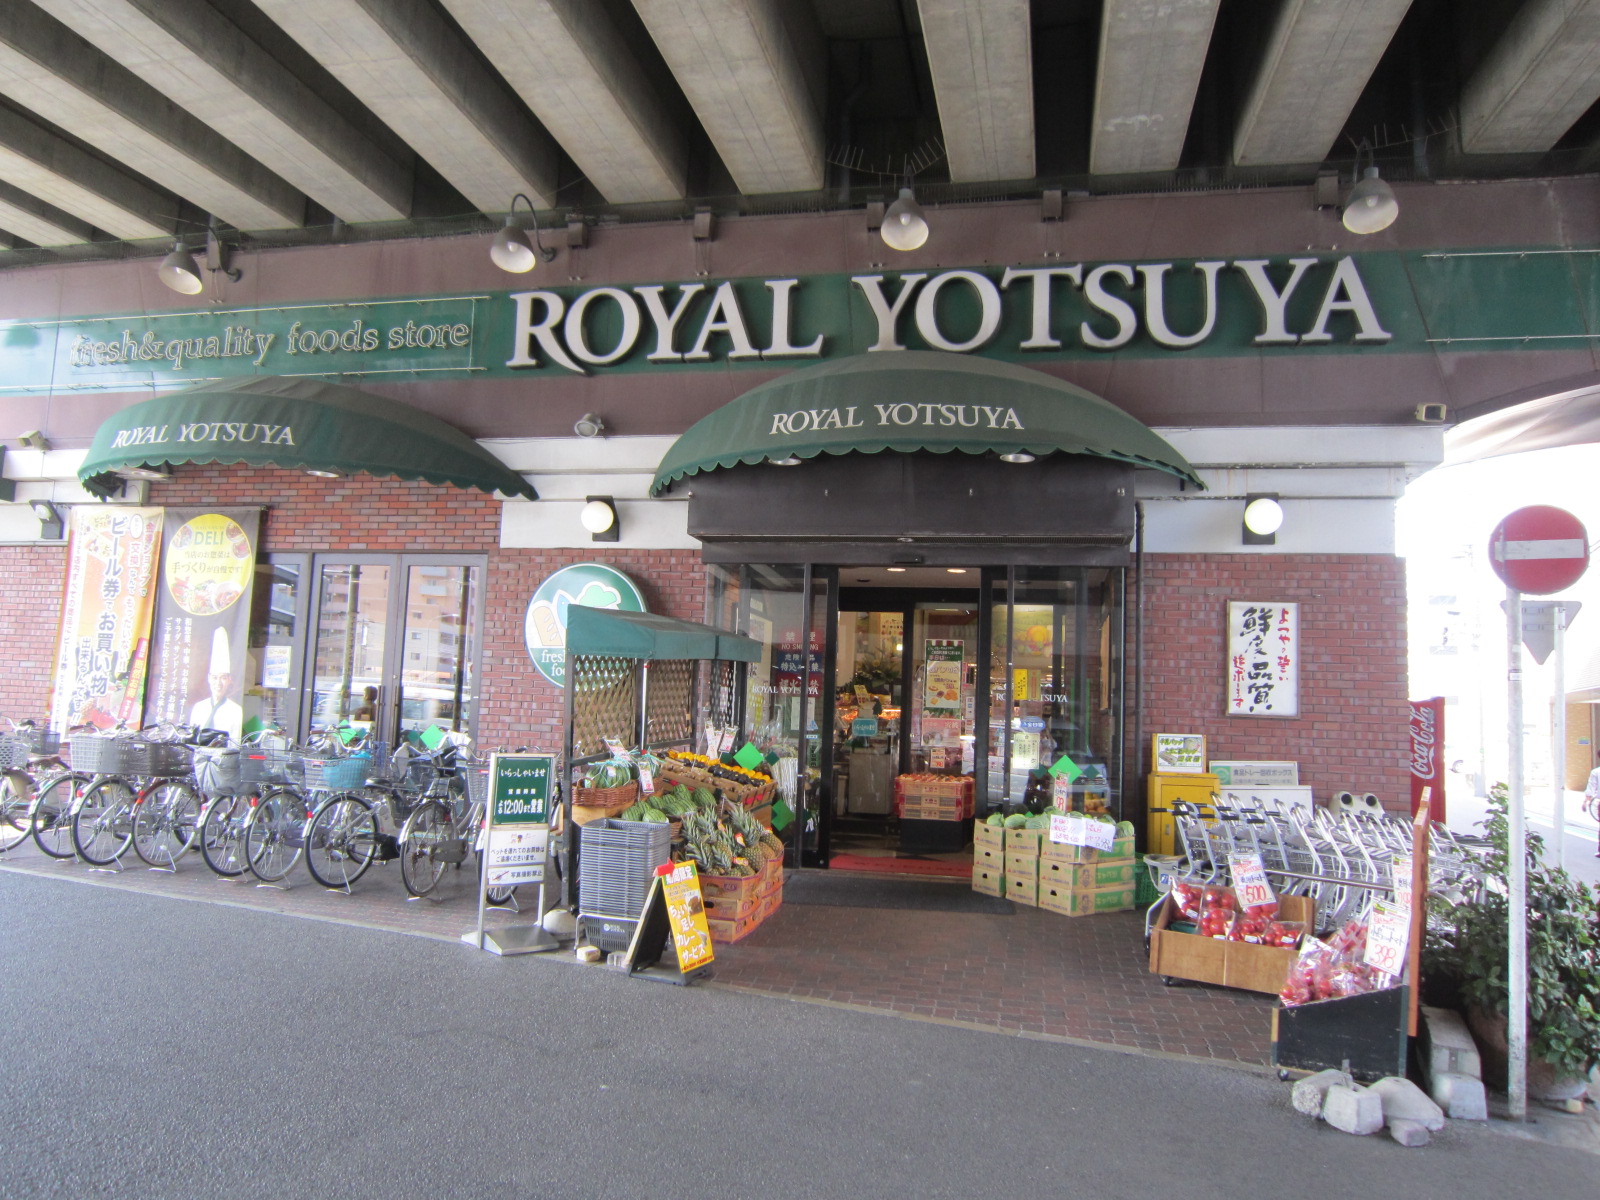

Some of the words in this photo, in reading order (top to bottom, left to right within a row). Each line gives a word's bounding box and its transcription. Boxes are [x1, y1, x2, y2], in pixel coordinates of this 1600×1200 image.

[506, 280, 825, 376] ROYAL
[853, 256, 1392, 352] YOTSUYA
[287, 320, 379, 354] foods
[388, 320, 470, 350] store
[770, 404, 864, 435] ROYAL
[875, 402, 1025, 430] YOTSUYA
[111, 425, 169, 449] ROYAL
[177, 422, 295, 447] YOTSUYA
[194, 531, 225, 546] DELI
[1240, 606, 1275, 713] 鮮度品質
[752, 686, 779, 694] ROYAL
[780, 686, 818, 695] YOTSYA
[500, 768, 547, 778] いらっしゃいませ
[1245, 884, 1267, 903] 500
[676, 932, 696, 947] カレー
[682, 943, 706, 964] サービス
[1374, 944, 1397, 969] 398
